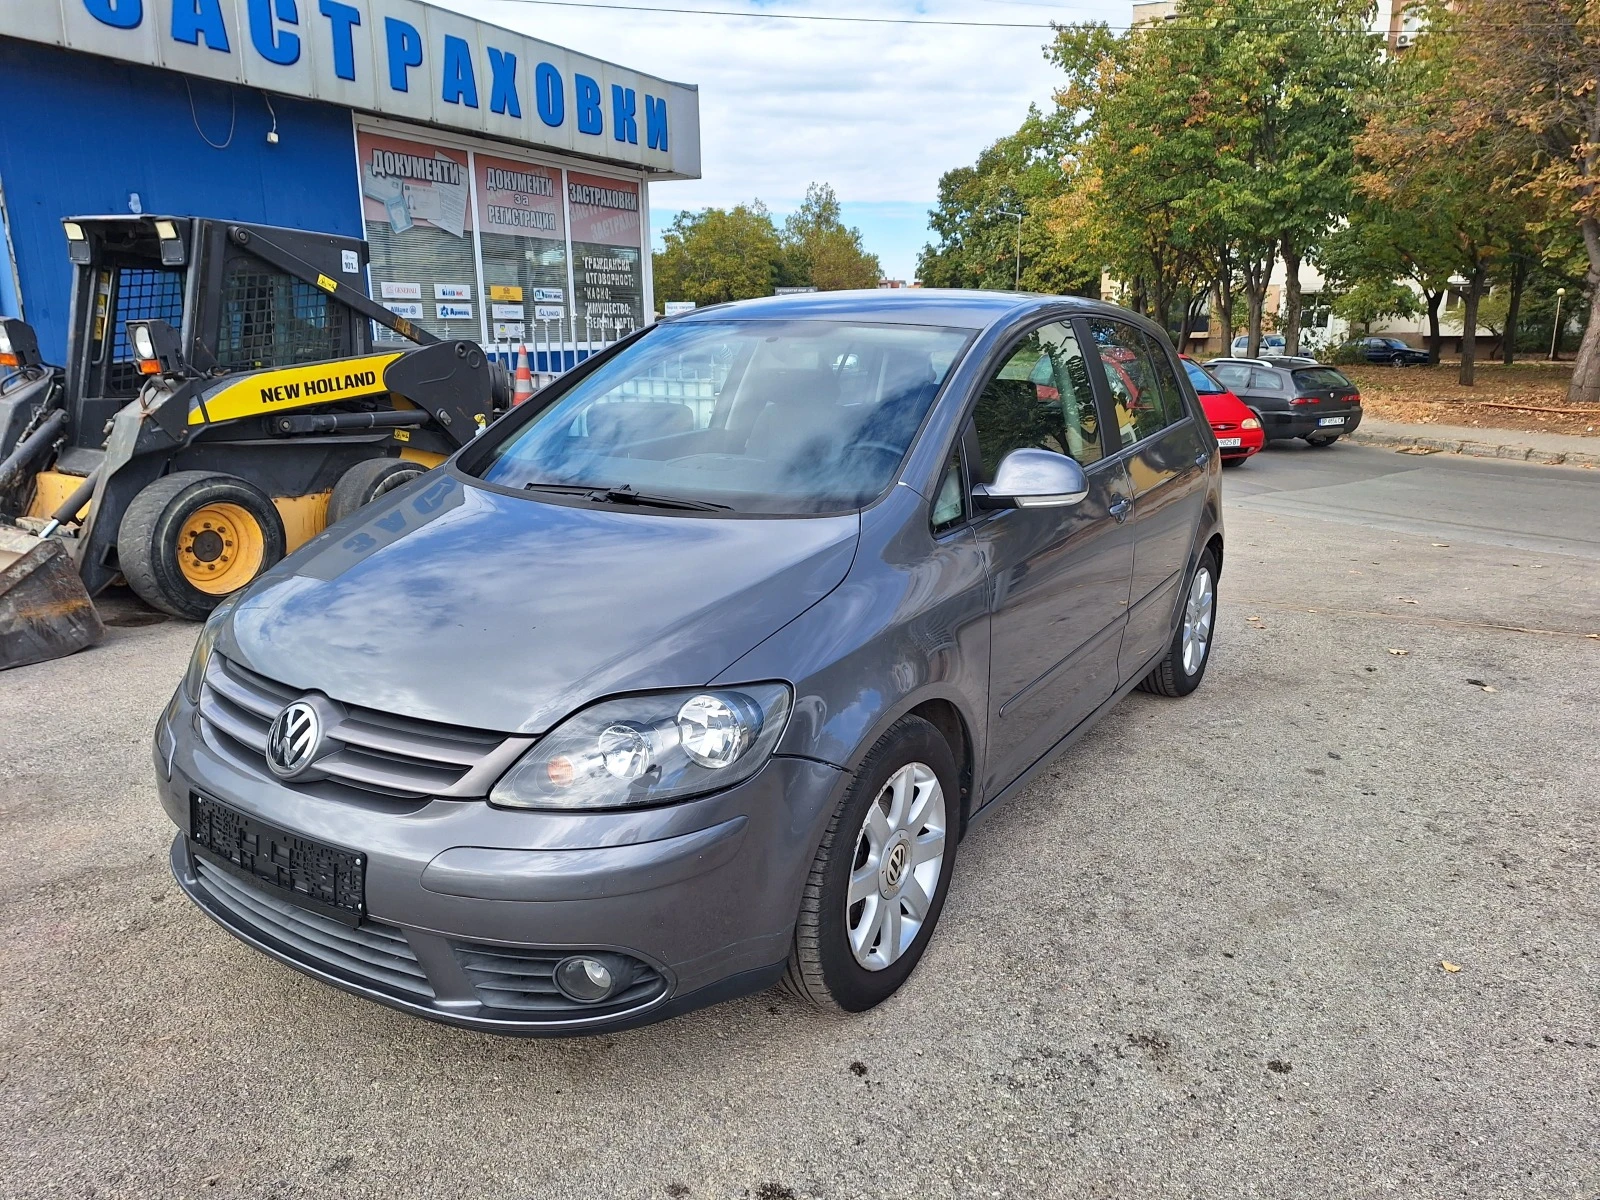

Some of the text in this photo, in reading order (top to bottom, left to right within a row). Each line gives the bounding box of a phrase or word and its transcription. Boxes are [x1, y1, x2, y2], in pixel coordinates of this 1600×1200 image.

[371, 148, 460, 185] ДОКУМЕНТИ
[486, 167, 554, 197] ДОКУМЕНТИ
[514, 194, 529, 206] за
[569, 183, 638, 212] ЗАСТРАХОВКИ
[487, 205, 556, 231] РЕГИСТРАЦИЯ
[260, 371, 376, 403] NEW HOLLAND
